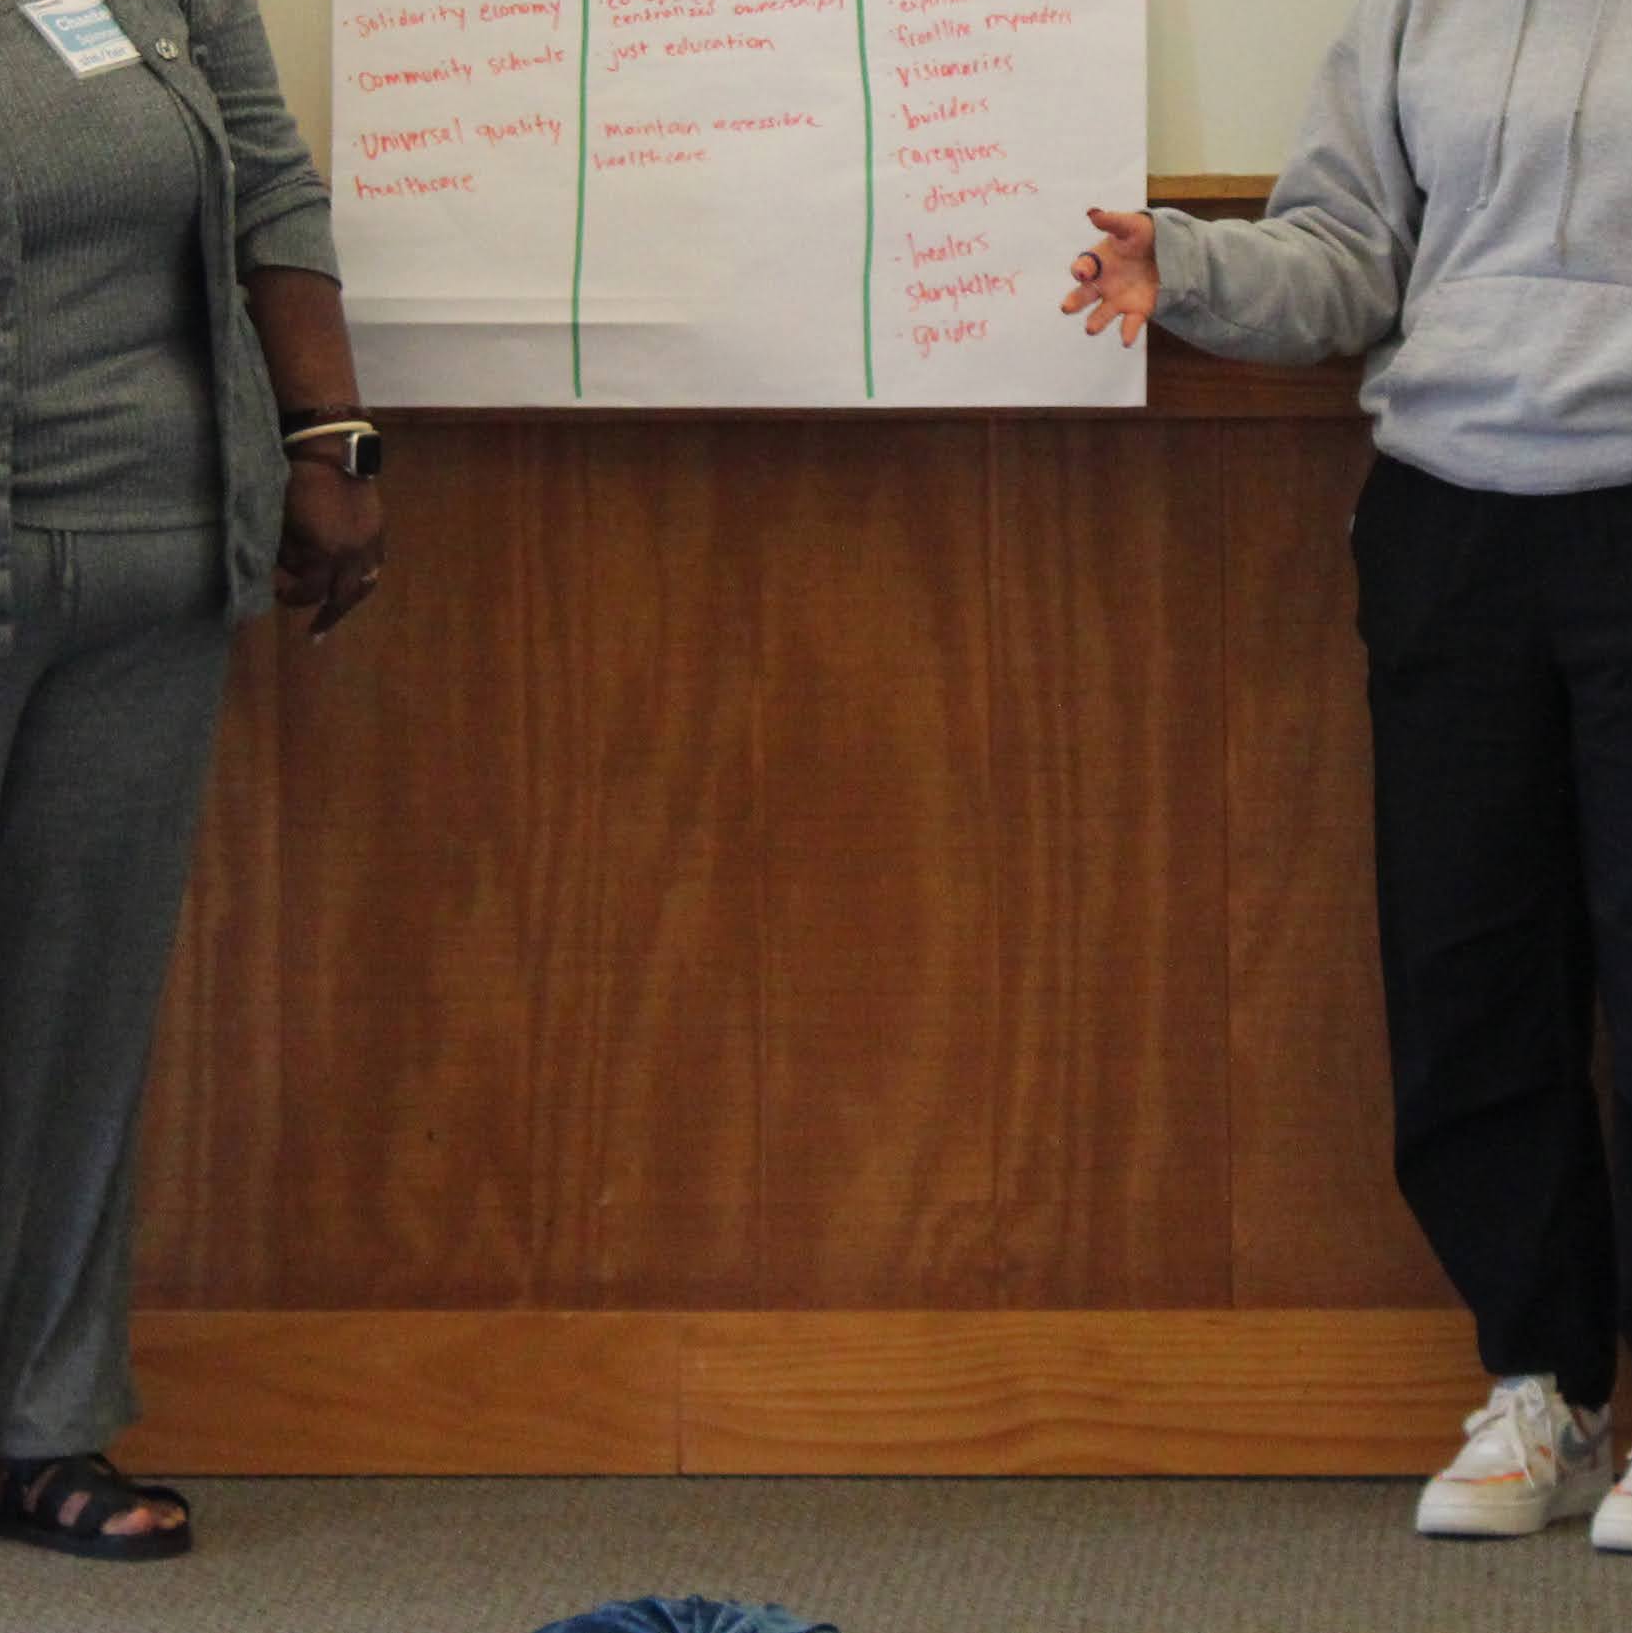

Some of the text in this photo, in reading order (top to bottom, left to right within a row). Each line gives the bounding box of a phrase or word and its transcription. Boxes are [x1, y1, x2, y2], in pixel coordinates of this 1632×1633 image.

[606, 33, 776, 72] just education
[901, 95, 990, 131] builders
[360, 112, 562, 161] Universal quality
[905, 231, 990, 270] healers
[912, 318, 989, 359] guides
